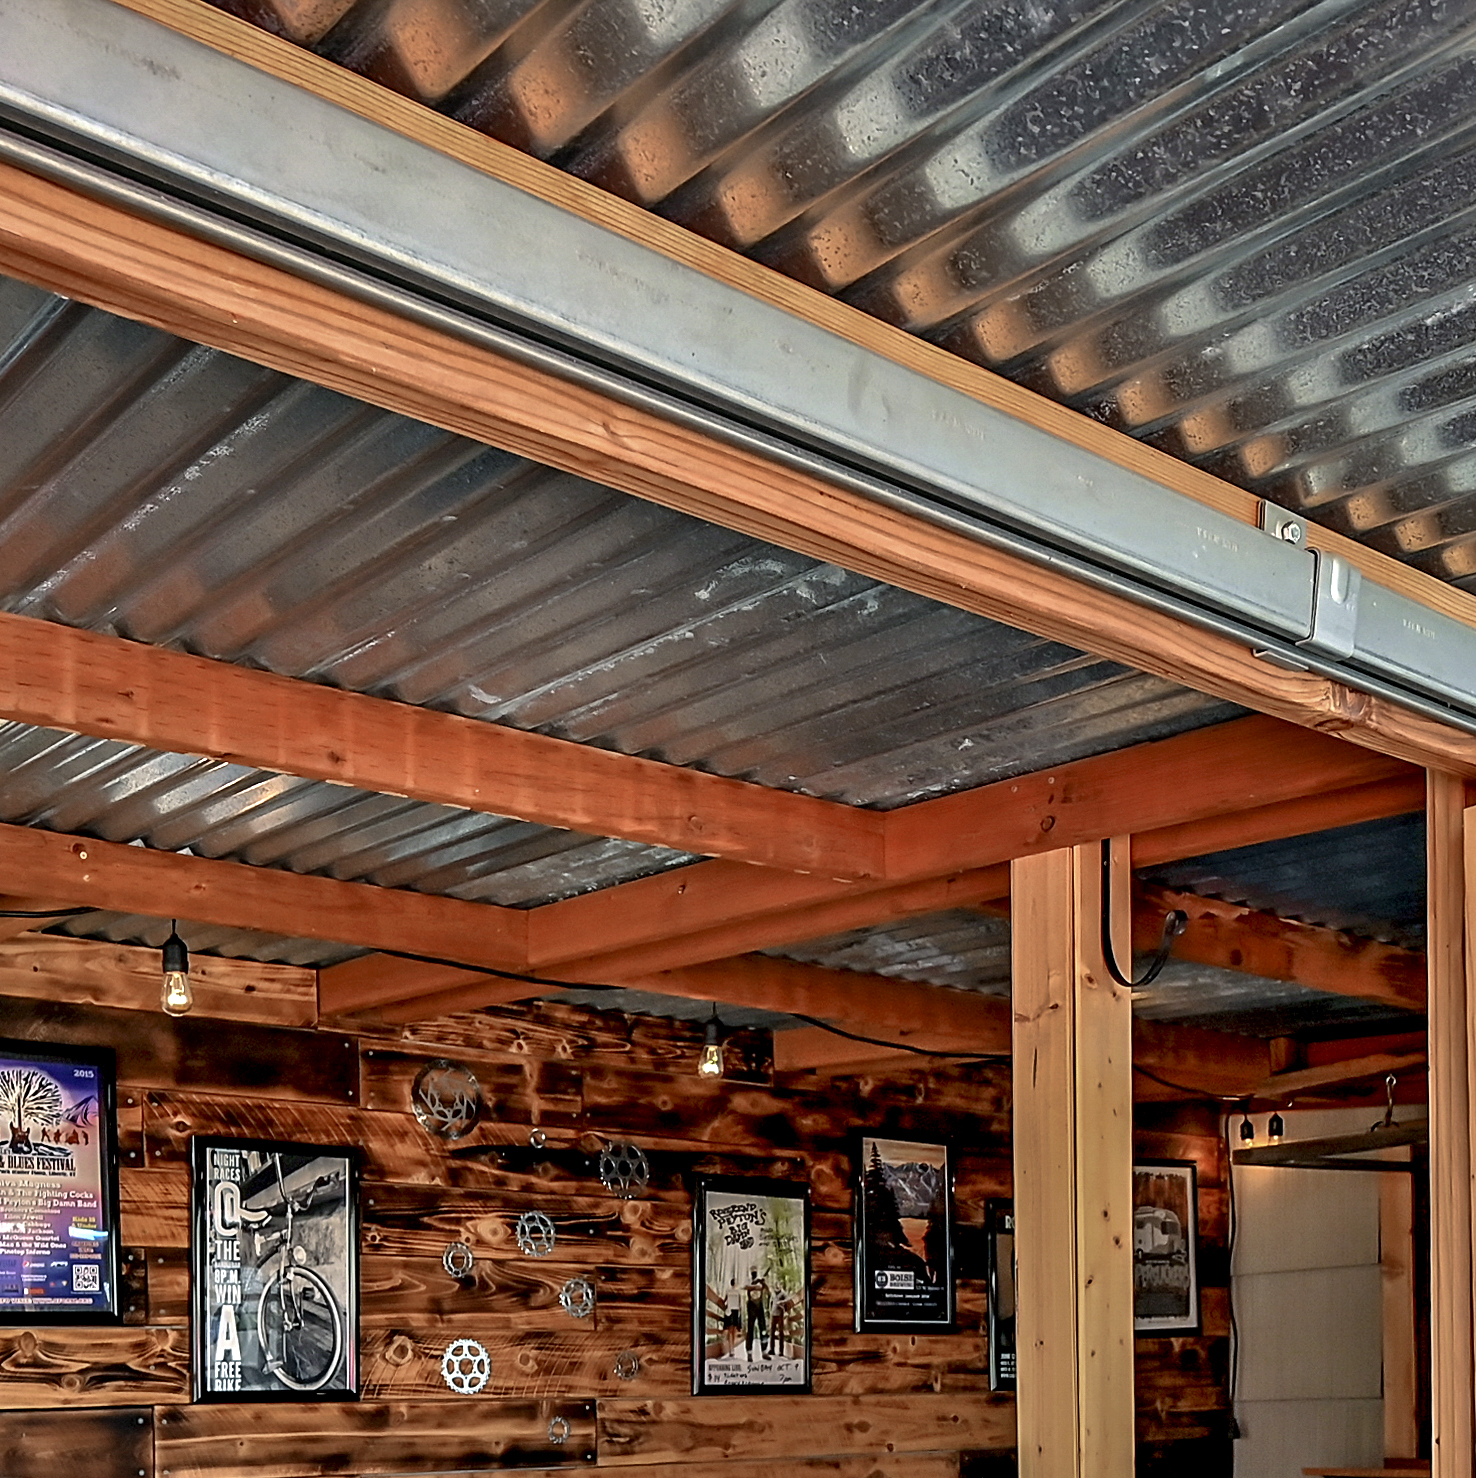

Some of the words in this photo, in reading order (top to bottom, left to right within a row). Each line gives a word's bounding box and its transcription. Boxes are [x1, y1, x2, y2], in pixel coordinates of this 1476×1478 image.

[74, 1070, 94, 1078] 2015
[8, 1156, 34, 1169] BLUES
[37, 1157, 76, 1171] FESTIVAL
[214, 1153, 240, 1167] NIGHT
[214, 1167, 240, 1181] RACES
[38, 1198, 51, 1208] Big
[53, 1199, 75, 1207] Damn
[77, 1199, 97, 1208] Band
[717, 1208, 767, 1230] PEYTON'S
[729, 1222, 748, 1235] BIG
[215, 1240, 241, 1261] THE
[214, 1269, 241, 1284] 8P.M.
[215, 1284, 241, 1304] WIN
[215, 1305, 241, 1361] A
[215, 1361, 242, 1379] FREE
